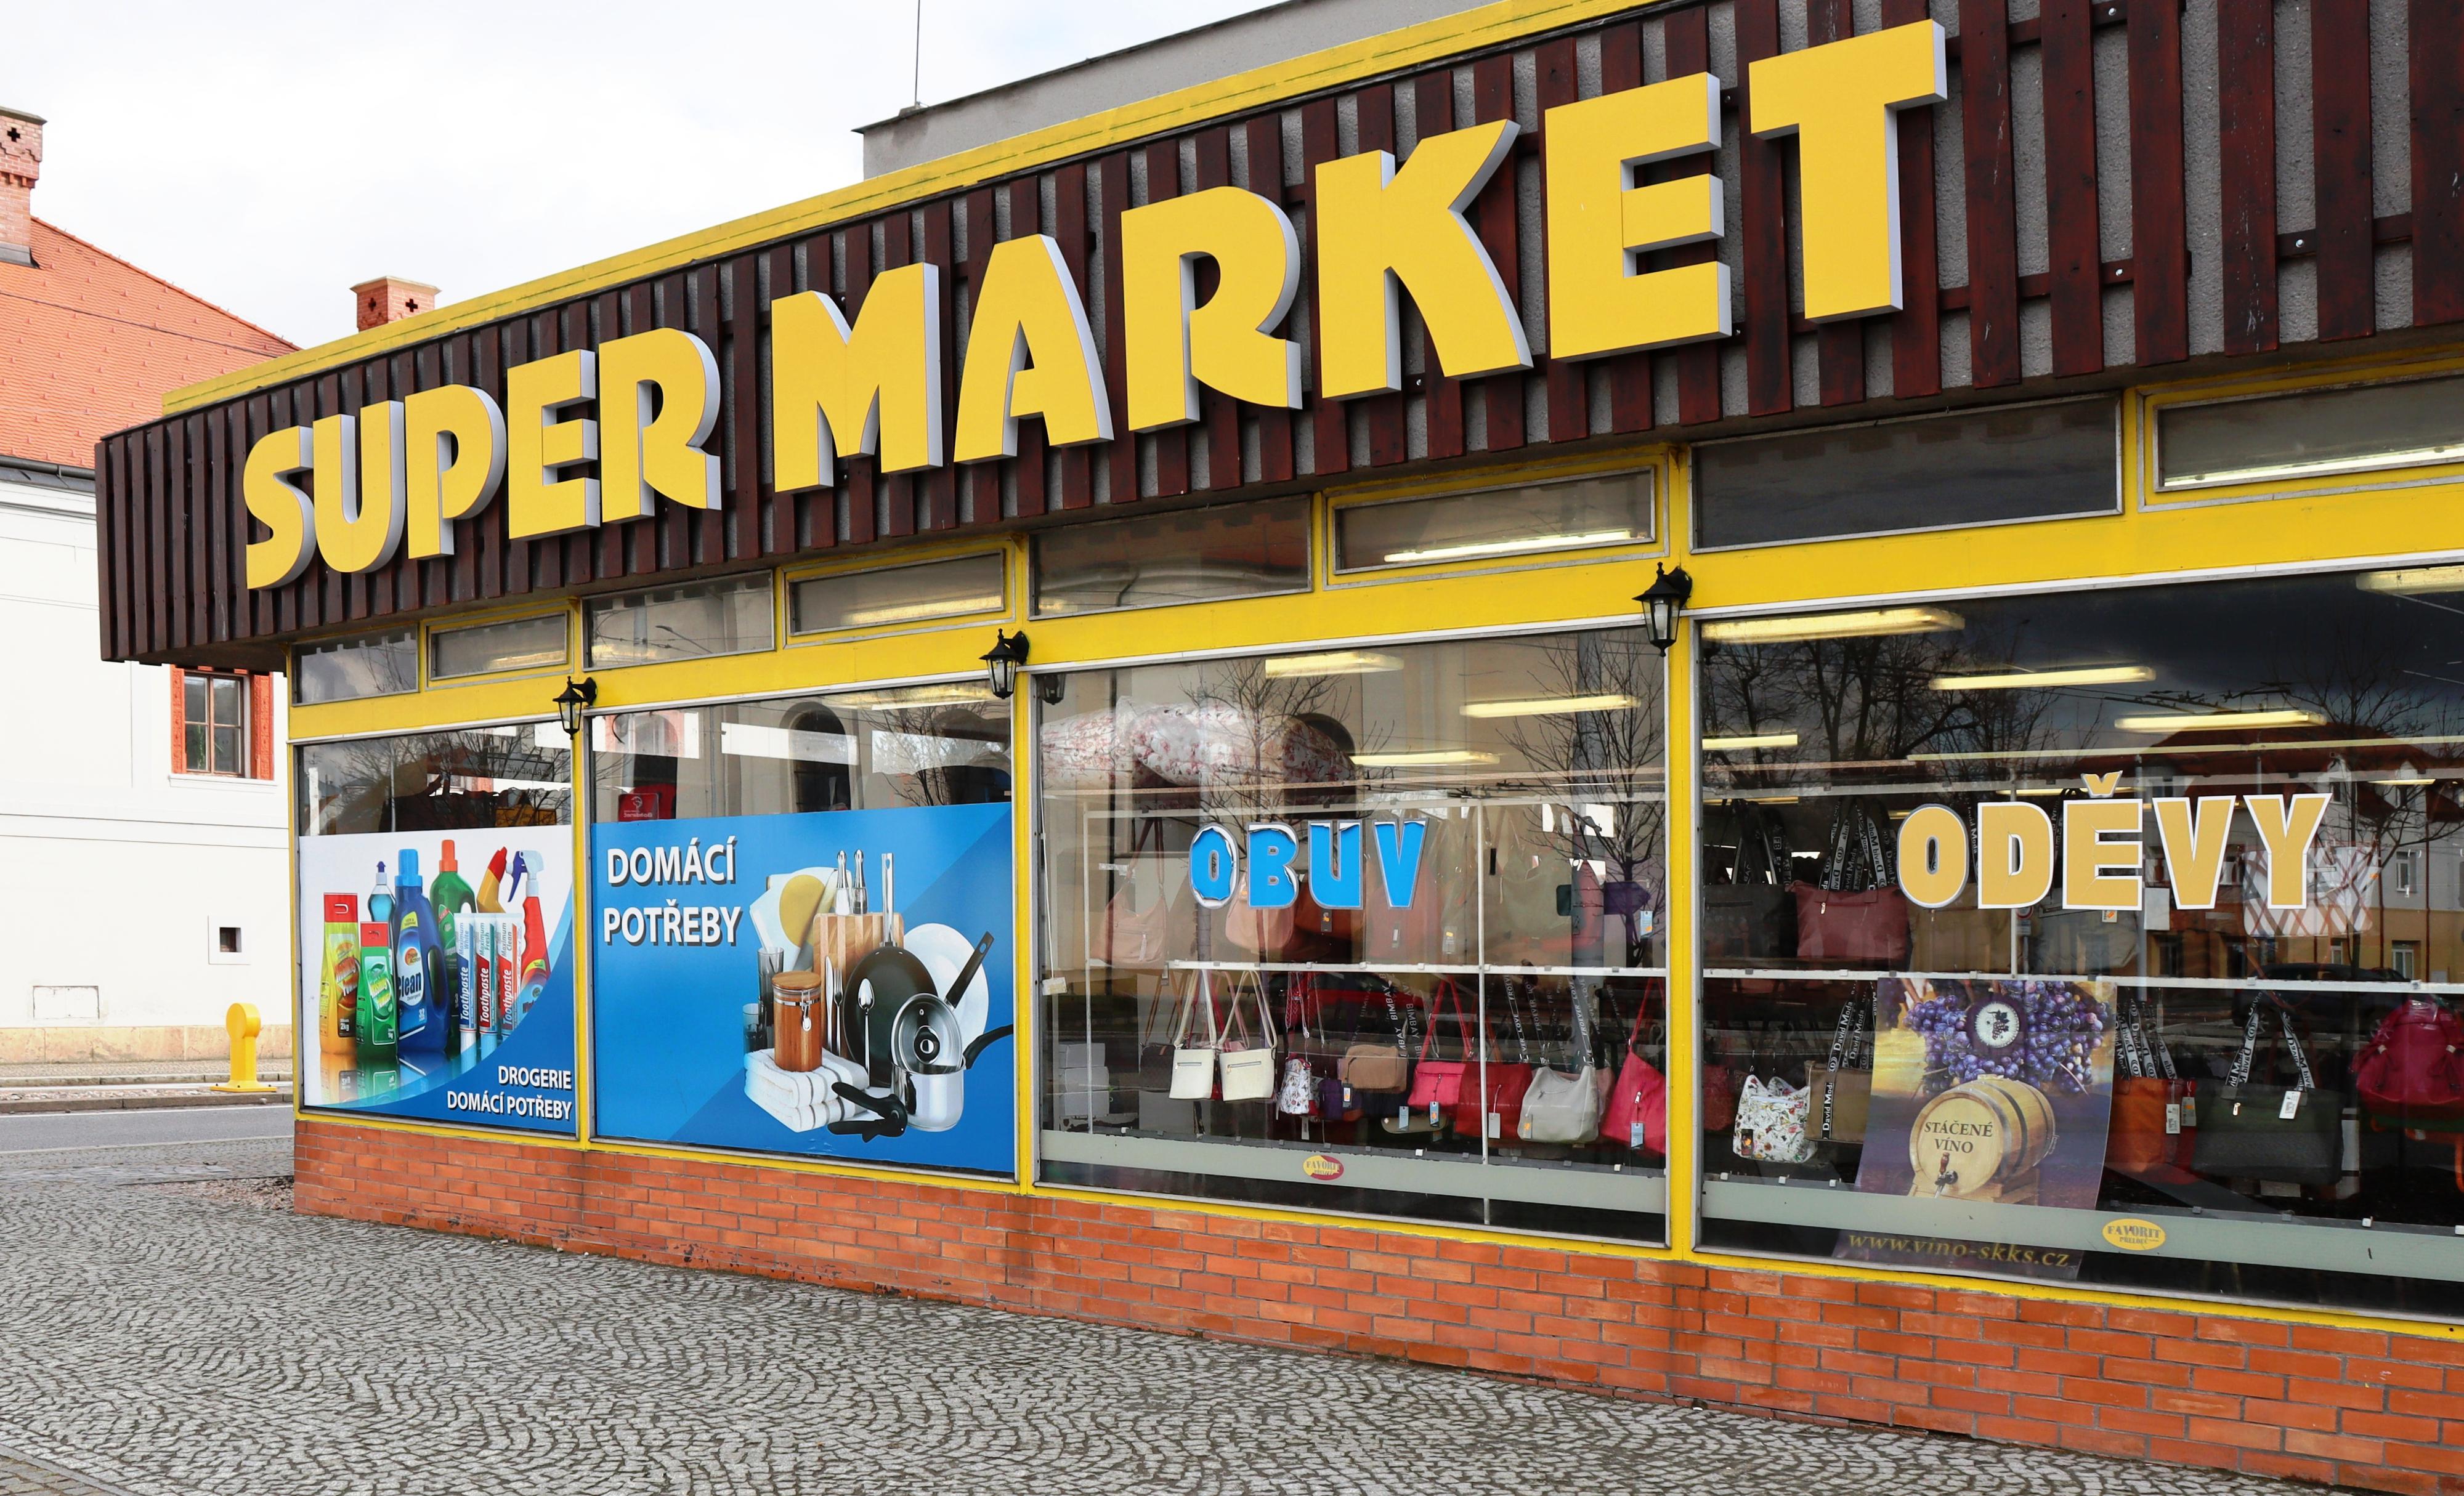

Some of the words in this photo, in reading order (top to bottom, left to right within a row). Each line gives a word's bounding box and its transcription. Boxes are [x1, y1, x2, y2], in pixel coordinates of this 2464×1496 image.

[243, 328, 721, 590] SUPER
[771, 18, 1947, 493] MARKET
[1897, 770, 2333, 910] ODĚVY
[607, 835, 737, 886] DOMÁCÍ
[1189, 819, 1429, 910] OBUV
[604, 899, 742, 945] POTŘEBY
[461, 966, 471, 1021] Toothpaste
[480, 968, 490, 1023] Toothpaste
[503, 969, 514, 1025] Toothpaste
[1382, 985, 1398, 1020] BIMBAY
[1406, 1003, 1420, 1038] BIMBAY
[1575, 1005, 1588, 1036] FROEVER
[1833, 1027, 1846, 1051] David
[1841, 1001, 1853, 1025] Moda
[1850, 1035, 1860, 1059] David
[1855, 1010, 1864, 1033] Moda
[498, 1065, 572, 1090] DROGERIE
[447, 1090, 505, 1114] DOMÁCÍ
[507, 1094, 572, 1120] POTŘEBY
[1823, 1107, 1831, 1131] David
[1924, 1120, 1993, 1137] STÁČENÉ
[1935, 1137, 1974, 1154] VÍNO
[1849, 1234, 2070, 1268] www.vino-skks.cz
[2107, 1225, 2161, 1238] FAVORIT
